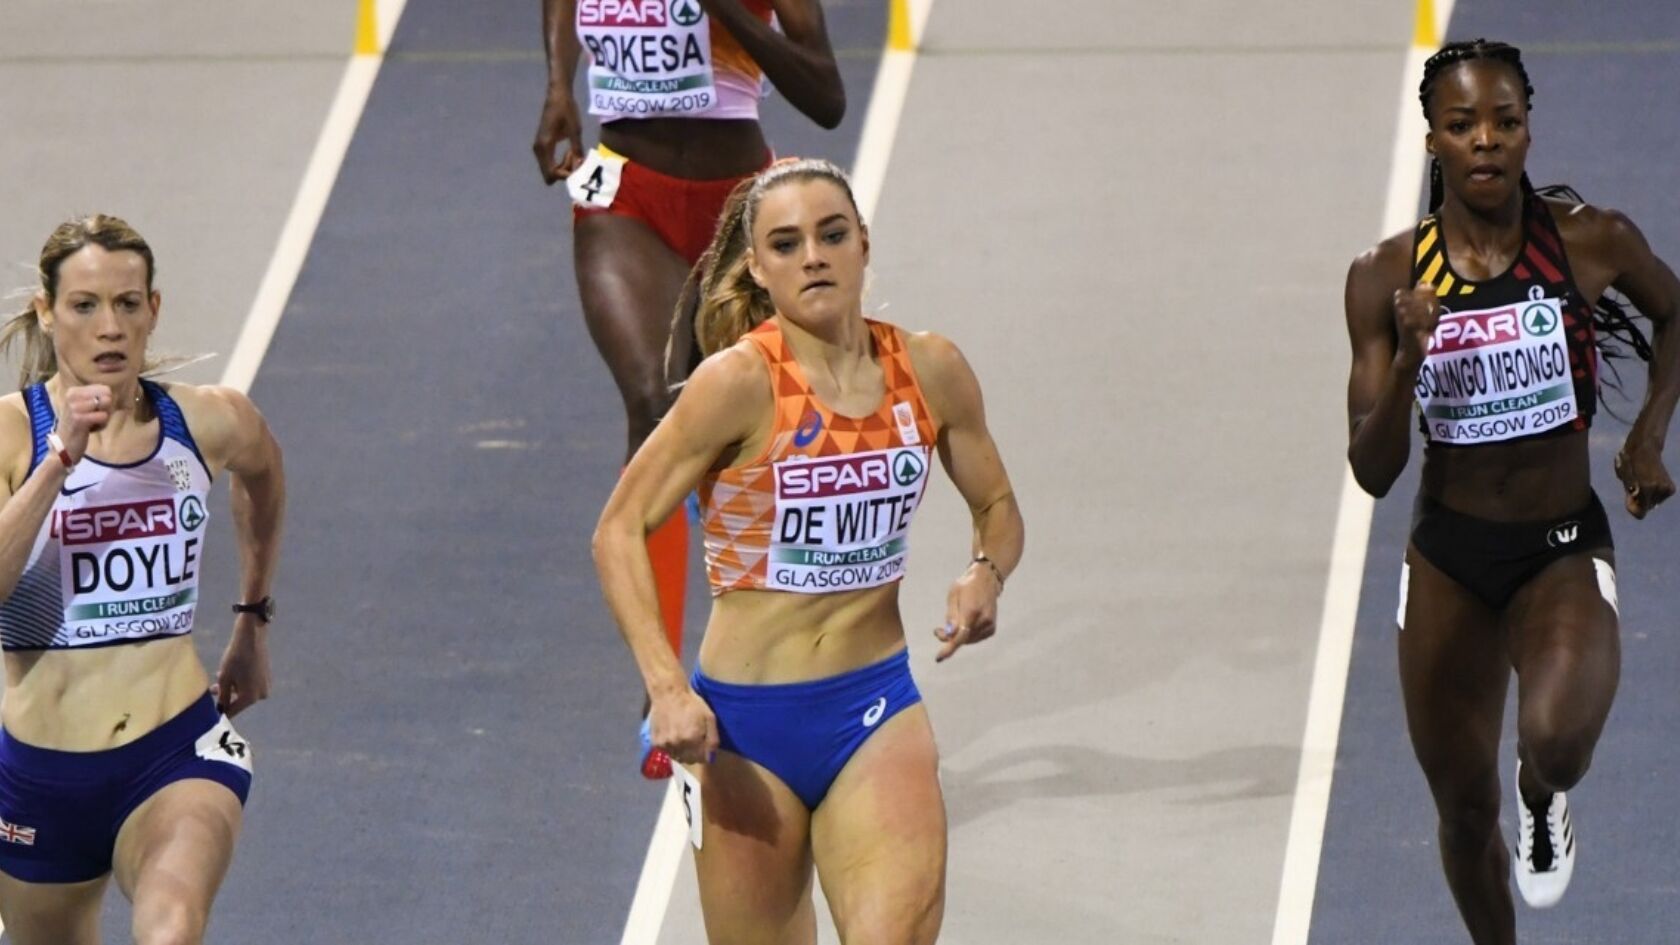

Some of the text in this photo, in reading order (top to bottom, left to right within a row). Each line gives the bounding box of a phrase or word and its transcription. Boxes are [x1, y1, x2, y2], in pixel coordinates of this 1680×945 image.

[580, 0, 666, 23] SPAR
[584, 33, 705, 73] BOKESA
[595, 93, 710, 113] GLASGOW 2019
[581, 165, 603, 201] 4
[1488, 342, 1566, 393] MBONGO
[1435, 402, 1571, 440] GLASGOW 2019
[1457, 403, 1489, 417] RUN
[781, 459, 888, 495] SPAR
[65, 504, 174, 540] SPAR
[780, 491, 917, 545] DE WITTE
[71, 537, 198, 595] DOYLE
[804, 551, 809, 563] I
[813, 551, 845, 565] RUN
[775, 566, 874, 588] GLASGOW
[99, 605, 104, 616] I
[107, 603, 140, 616] RUN
[76, 617, 170, 639] GLASGOW
